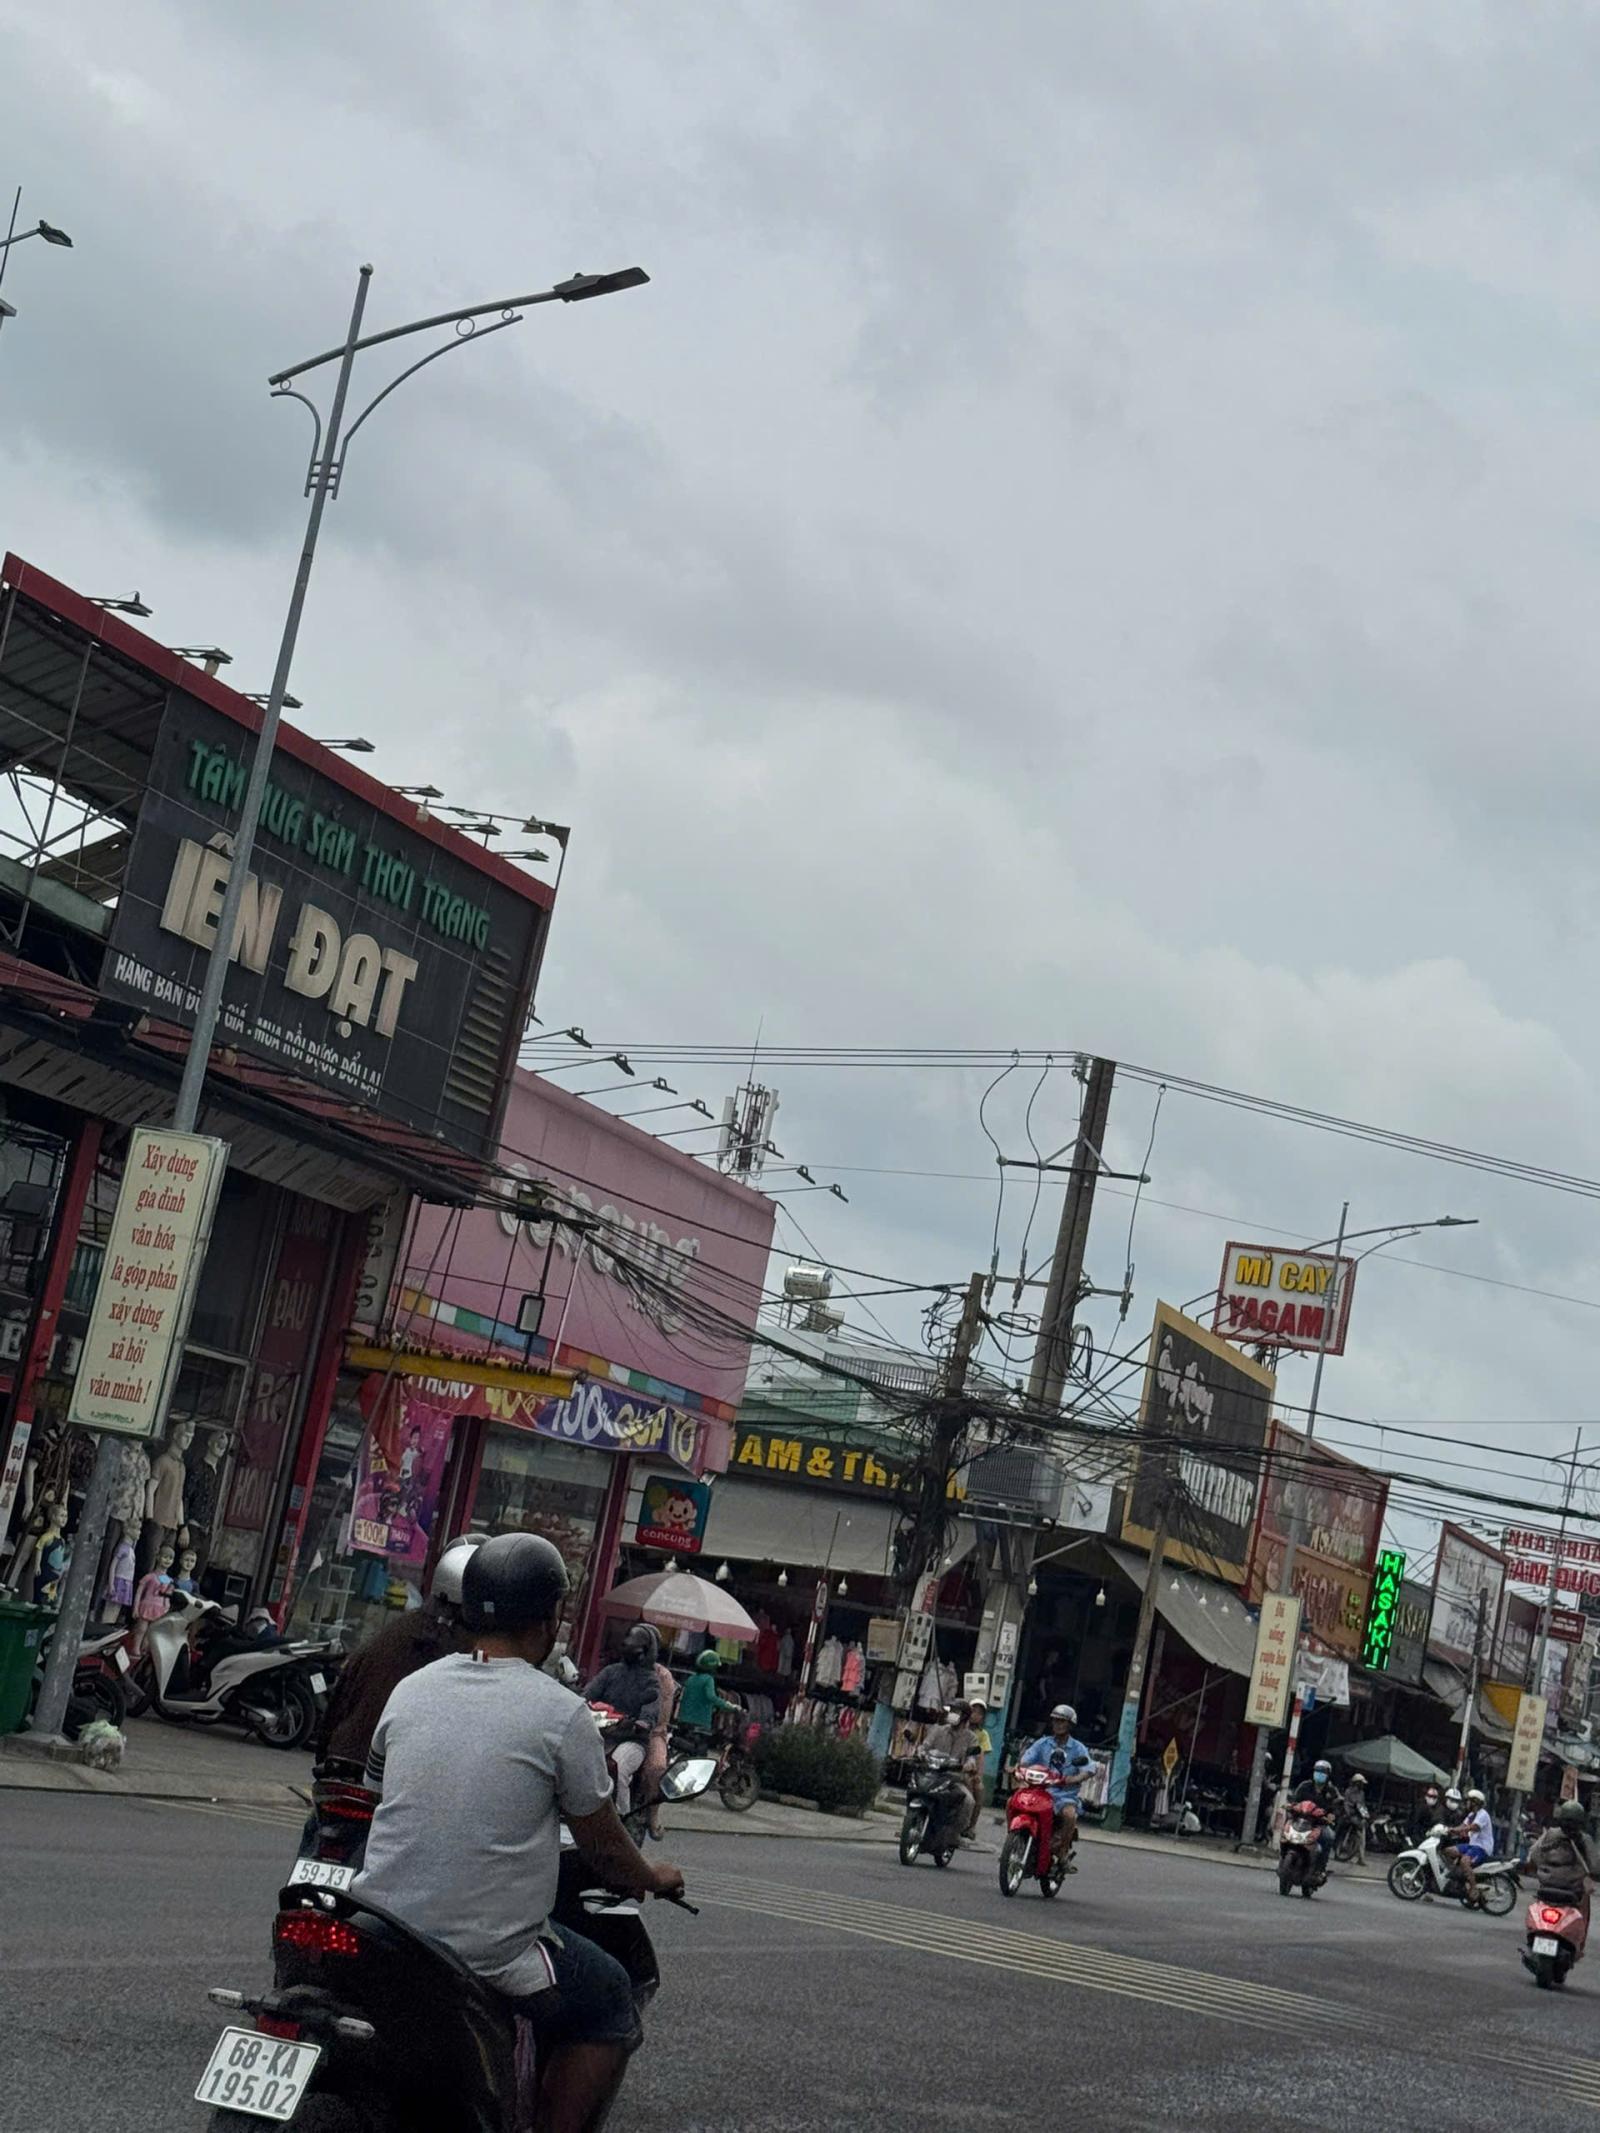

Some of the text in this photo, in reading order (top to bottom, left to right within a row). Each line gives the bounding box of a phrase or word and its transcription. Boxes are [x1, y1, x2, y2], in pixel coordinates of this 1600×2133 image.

[421, 878, 491, 951] TRANG
[284, 903, 419, 1039] ĐẠT
[114, 953, 153, 992] HÀNG
[154, 971, 183, 1006] BÁN
[223, 1002, 249, 1035] GIÁ
[142, 1144, 199, 1182] Xây dựng
[135, 1185, 186, 1214] gia đình
[131, 1224, 176, 1251] văn hóa
[110, 1256, 178, 1291] là góp phần
[1235, 1253, 1334, 1296] MÌ CAY
[108, 1296, 164, 1332] xây dựng
[108, 1336, 126, 1361] xã
[126, 1337, 148, 1369] hội
[88, 1374, 112, 1398] văn
[806, 1445, 835, 1479] &
[1369, 1554, 1400, 1666] HASAKI
[228, 2038, 300, 2079] 68-KA
[207, 2069, 296, 2114] 195.02
